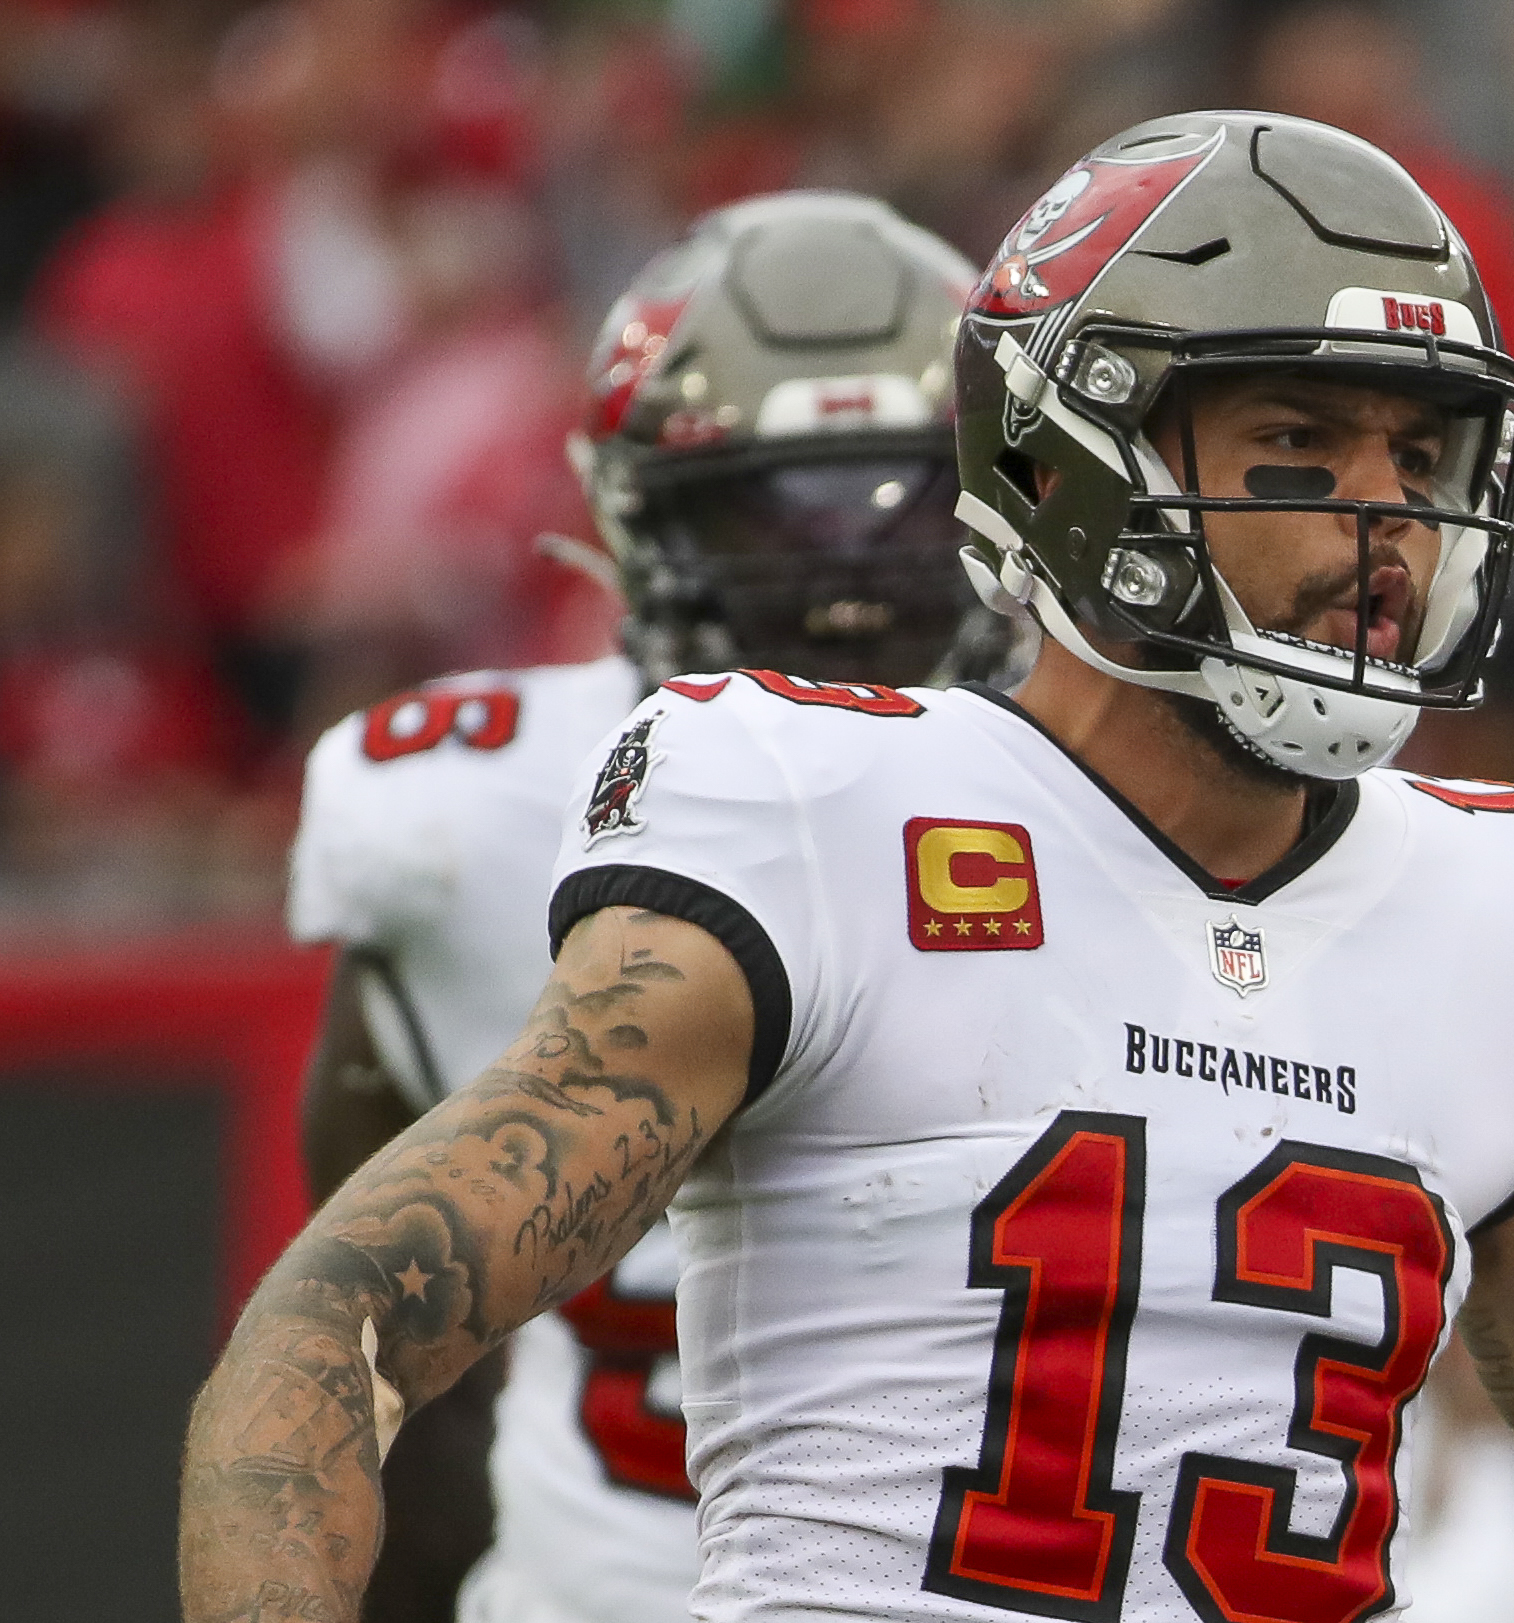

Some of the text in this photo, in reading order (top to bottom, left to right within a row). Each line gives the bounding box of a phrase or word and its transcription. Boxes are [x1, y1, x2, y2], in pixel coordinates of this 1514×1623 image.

[1381, 296, 1446, 336] BUCS
[916, 826, 1030, 914] C
[1219, 948, 1261, 981] NFL
[1123, 1021, 1356, 1115] BUCCANEERS
